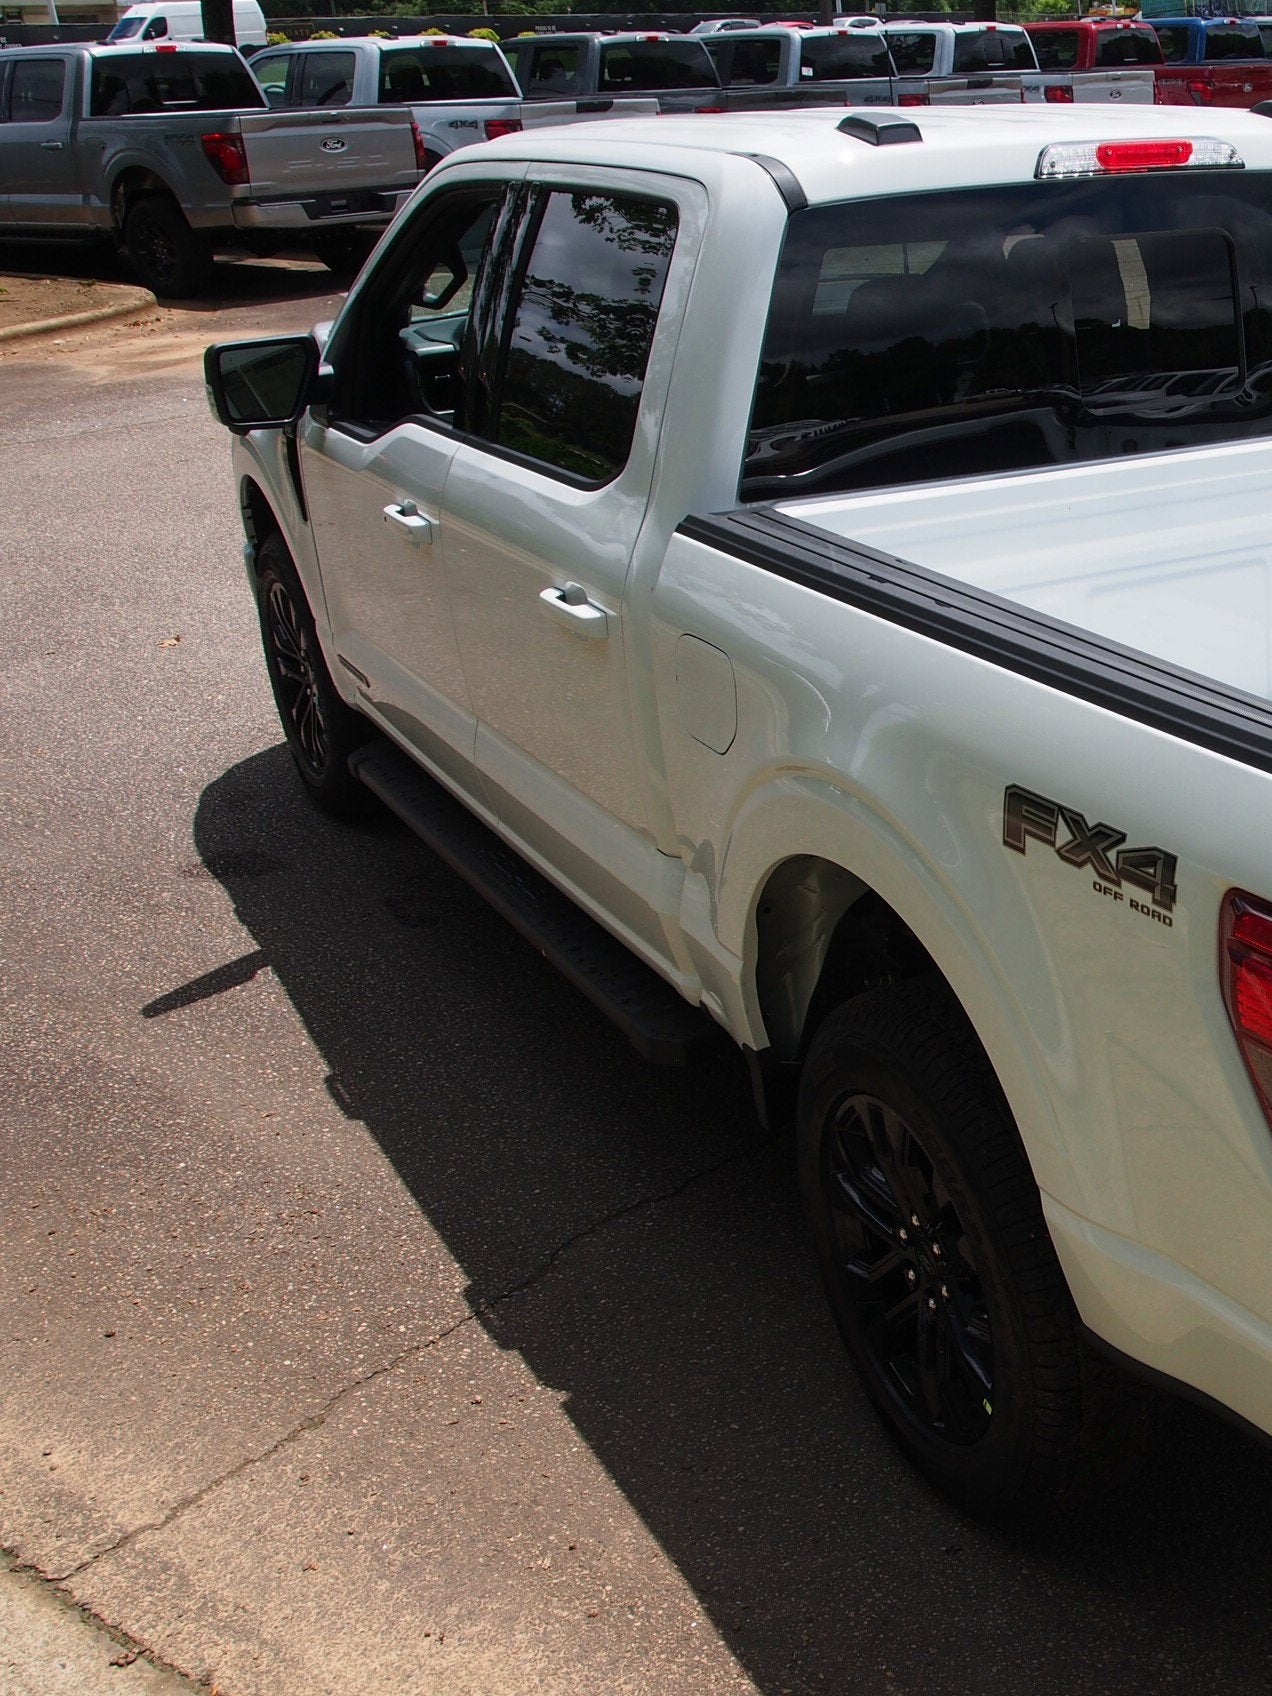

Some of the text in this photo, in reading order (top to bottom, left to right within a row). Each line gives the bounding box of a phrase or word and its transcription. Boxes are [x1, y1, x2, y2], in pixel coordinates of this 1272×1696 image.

[1003, 783, 1178, 913] FX4
[1092, 880, 1173, 927] OFF ROAD
